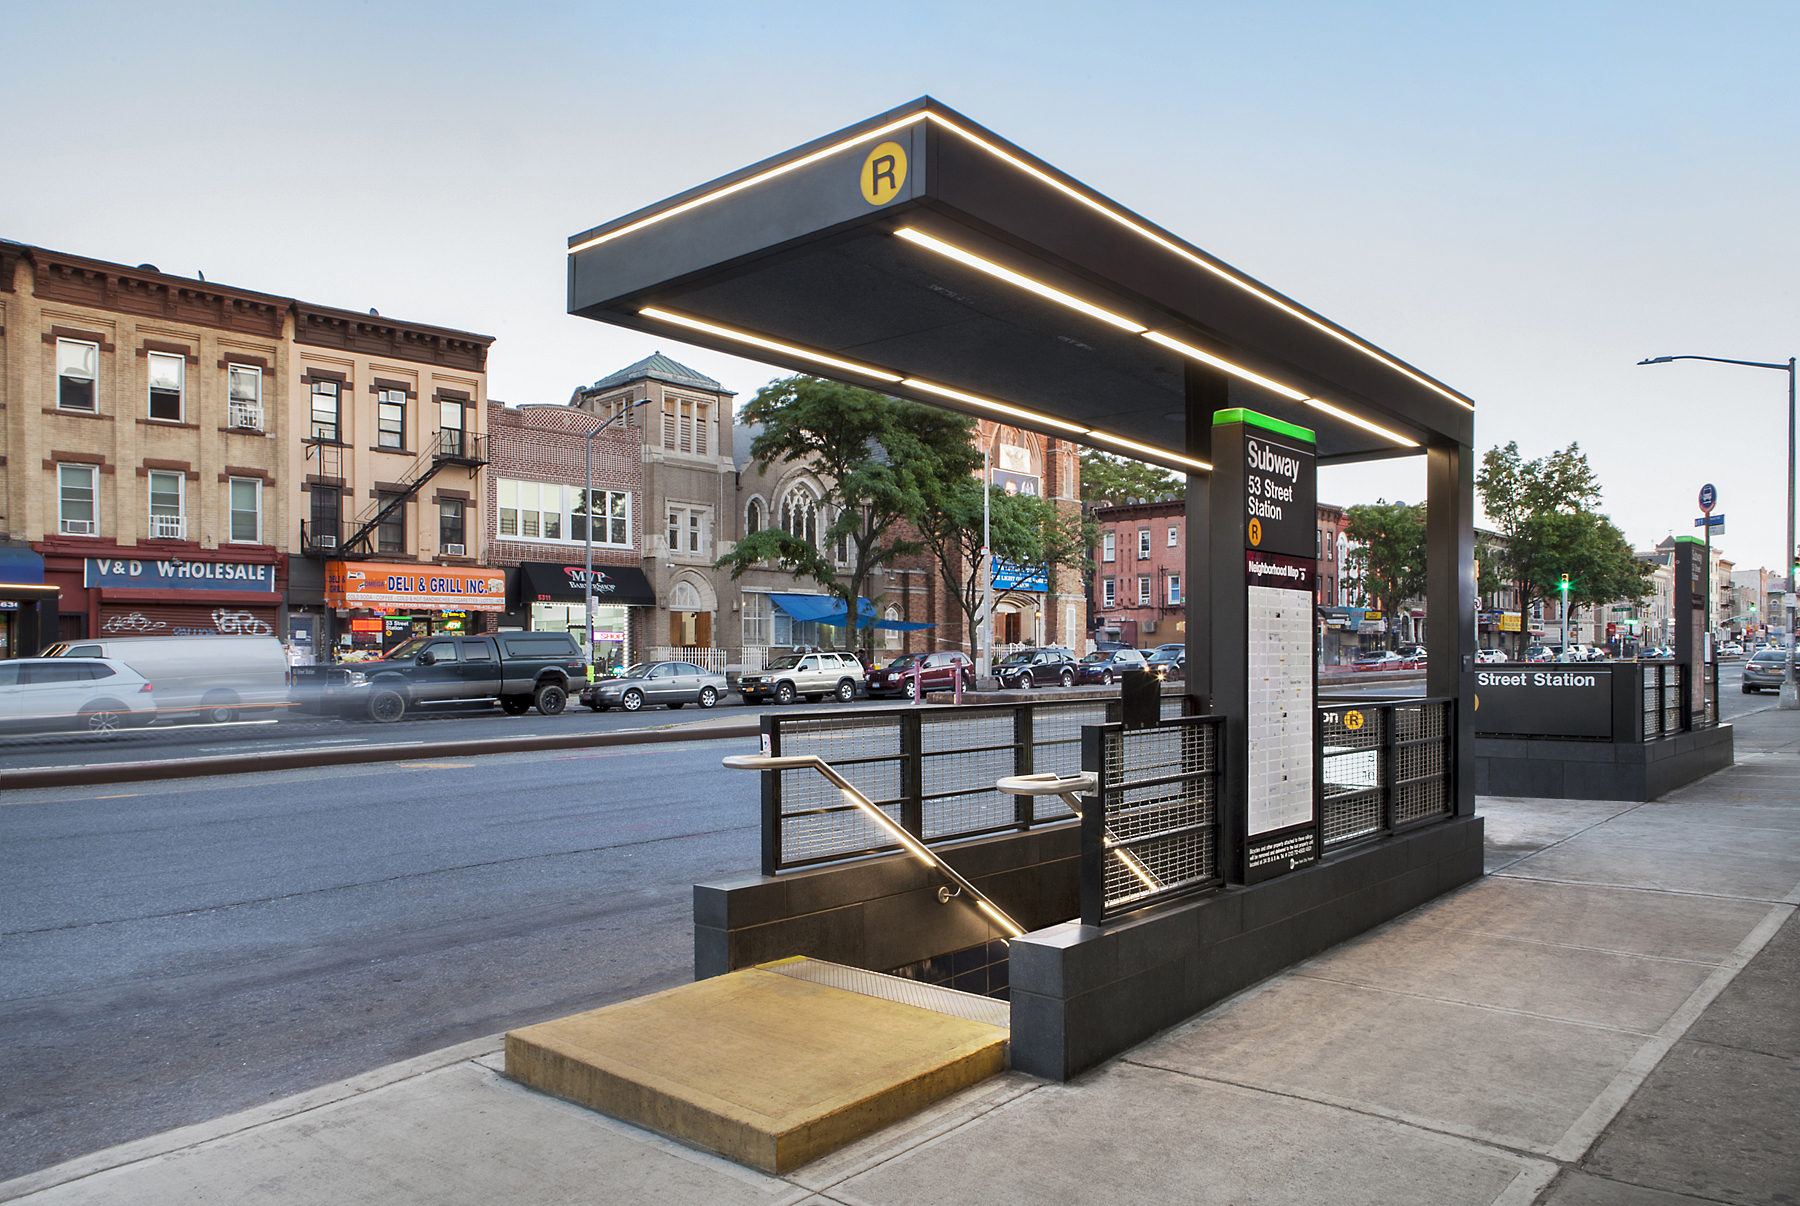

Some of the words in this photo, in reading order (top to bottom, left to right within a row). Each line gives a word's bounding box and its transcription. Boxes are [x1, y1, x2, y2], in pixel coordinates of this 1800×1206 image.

[872, 154, 896, 196] R
[1247, 440, 1299, 483] Subway
[1248, 475, 1261, 495] 53
[1264, 478, 1293, 502] Street
[1248, 496, 1282, 520] Station
[1251, 524, 1258, 540] R
[156, 561, 266, 581] WHOLESALE
[1248, 561, 1287, 577] Neighborhood
[1287, 565, 1299, 580] Map
[330, 585, 345, 593] GRILL
[364, 580, 385, 588] OMEGA
[387, 575, 414, 592] DELI
[418, 577, 427, 593] &
[430, 577, 463, 594] GRILL
[466, 579, 489, 595] INC.
[1478, 673, 1527, 686] Street
[1533, 673, 1595, 687] Station
